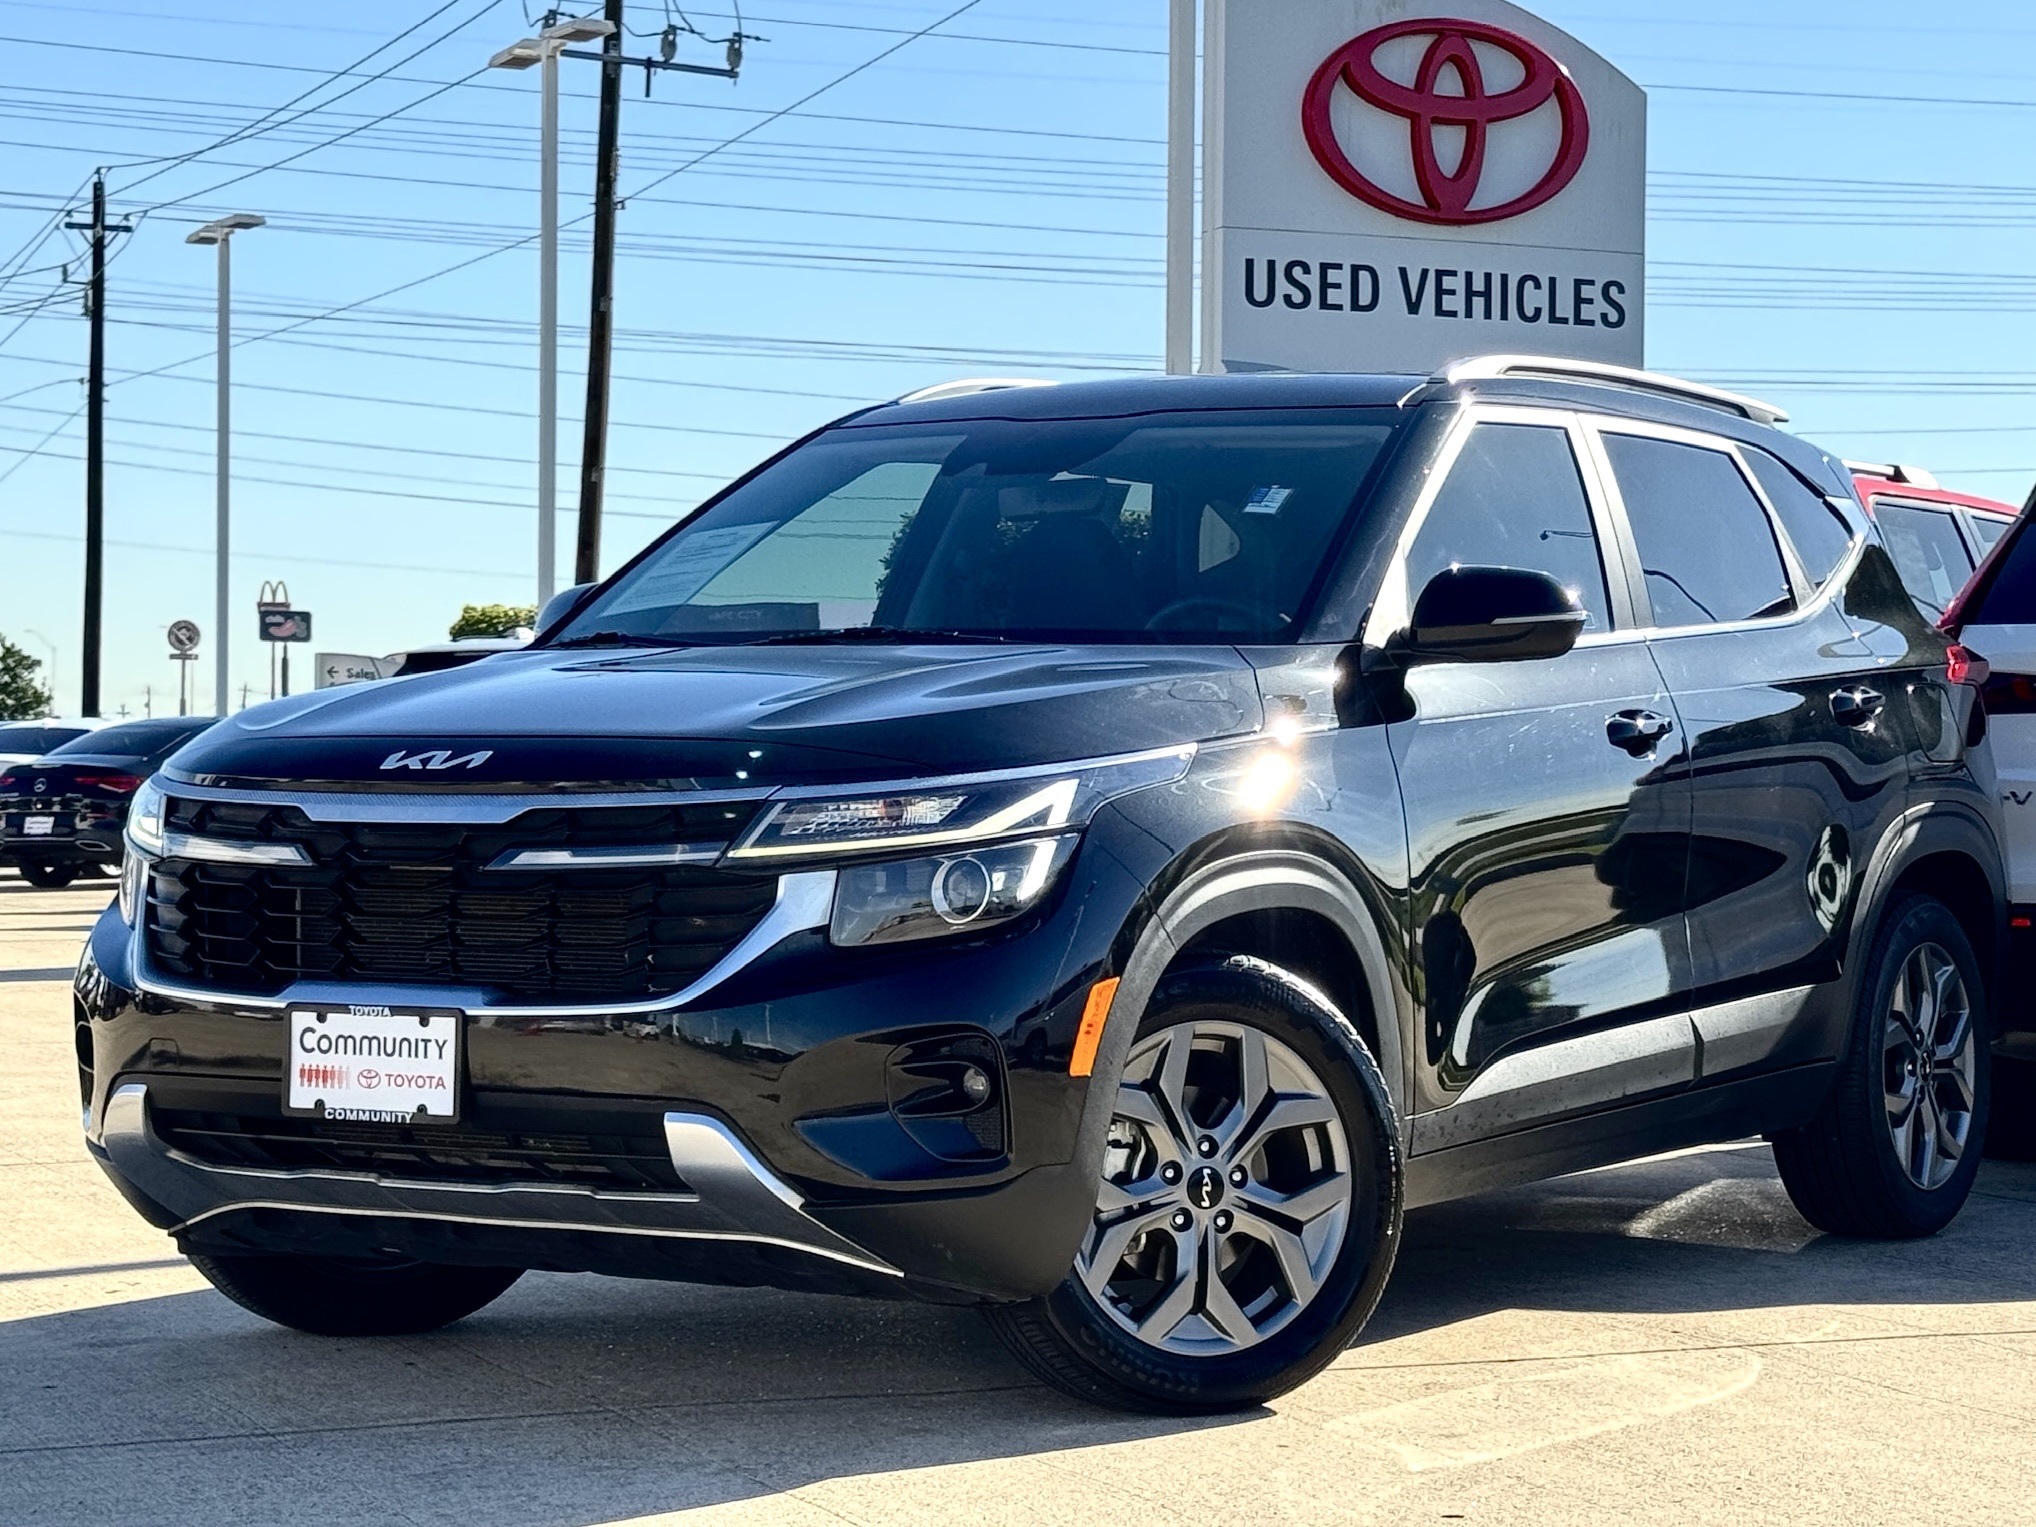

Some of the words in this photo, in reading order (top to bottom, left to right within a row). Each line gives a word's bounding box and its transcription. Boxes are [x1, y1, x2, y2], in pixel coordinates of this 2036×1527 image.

[1244, 258, 1380, 312] USED
[1398, 266, 1626, 329] VEHICLES
[346, 667, 376, 680] Sales
[380, 750, 494, 769] KIA
[348, 1005, 392, 1017] TOYOTA
[385, 1073, 446, 1090] TOYOTA
[325, 1108, 413, 1123] COMMUNITY
